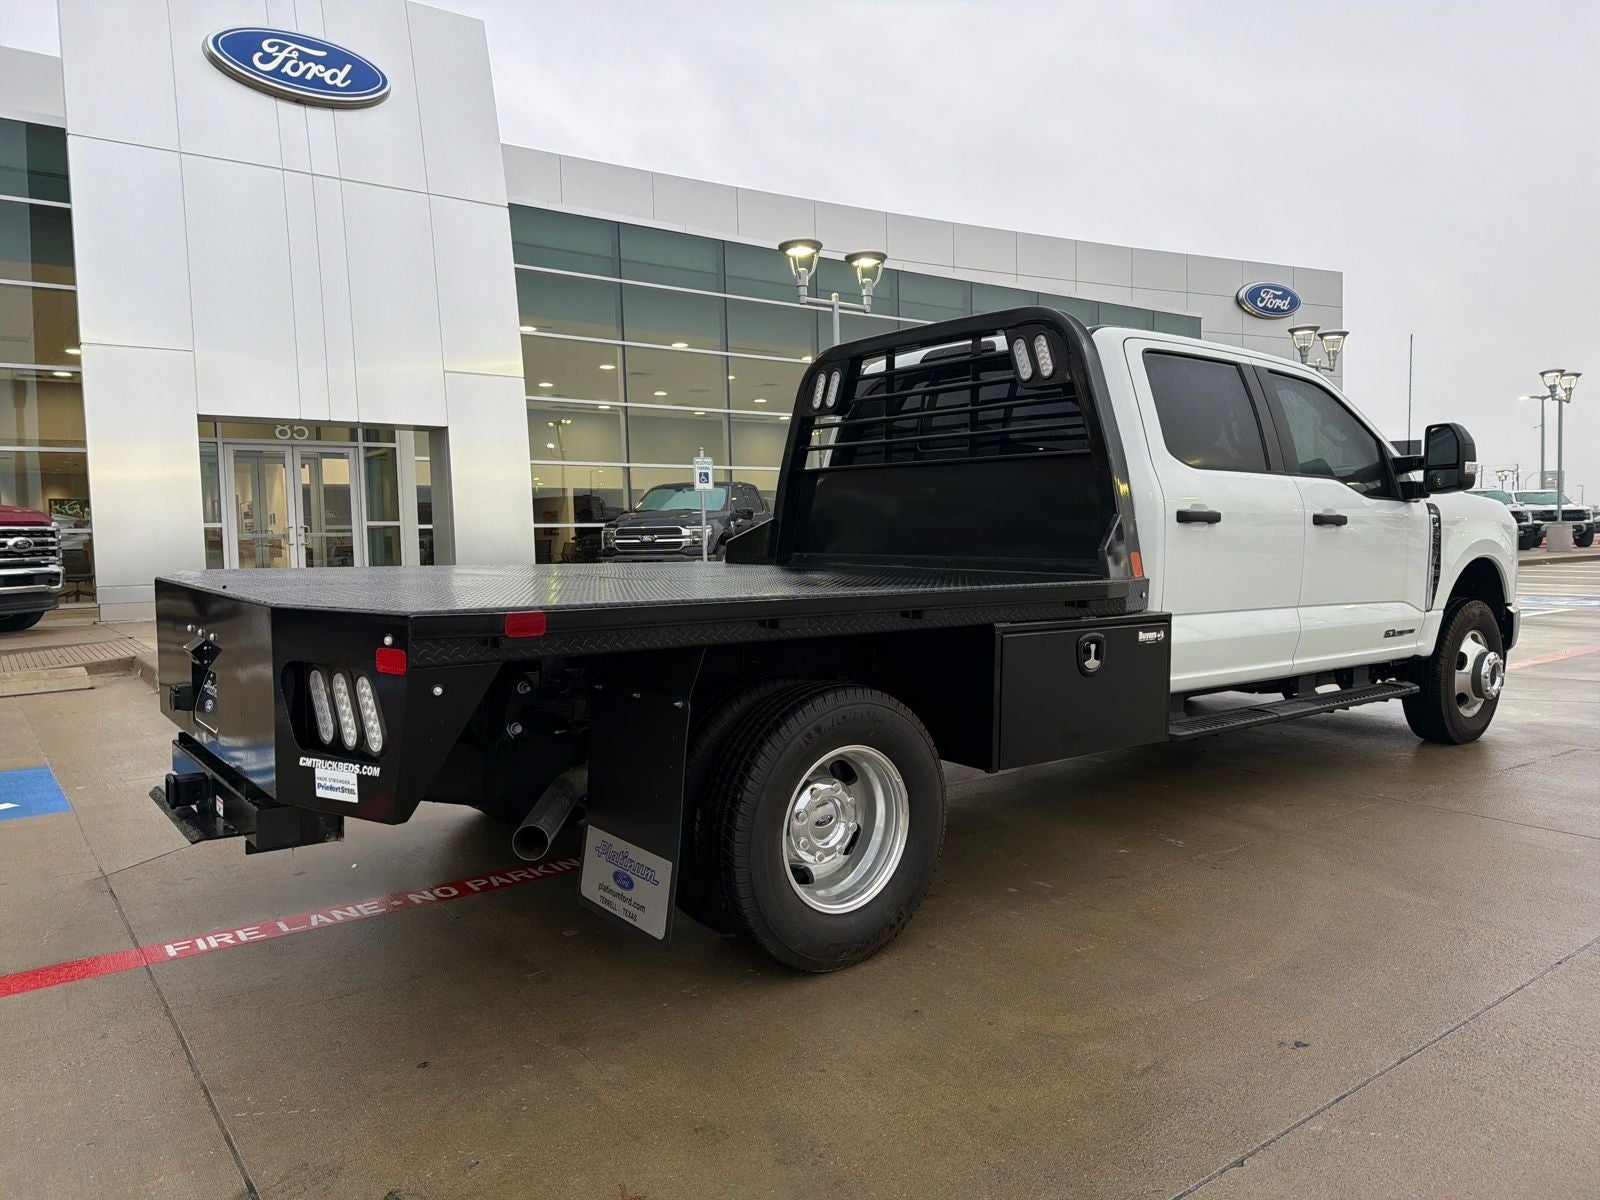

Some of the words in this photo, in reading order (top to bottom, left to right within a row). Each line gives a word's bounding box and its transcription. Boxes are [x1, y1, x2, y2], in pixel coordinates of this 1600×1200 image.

[252, 39, 352, 87] Ford
[1257, 288, 1291, 310] Ford
[299, 757, 380, 777] CMTRUCKBEDS.COM
[165, 926, 266, 957] FIRE
[276, 901, 386, 932] LANE
[407, 886, 459, 905] NO
[465, 857, 581, 891] PARKIN
[598, 882, 646, 913] platinumford.com
[599, 894, 618, 912] TERRELL
[622, 907, 638, 922] TEXAS
